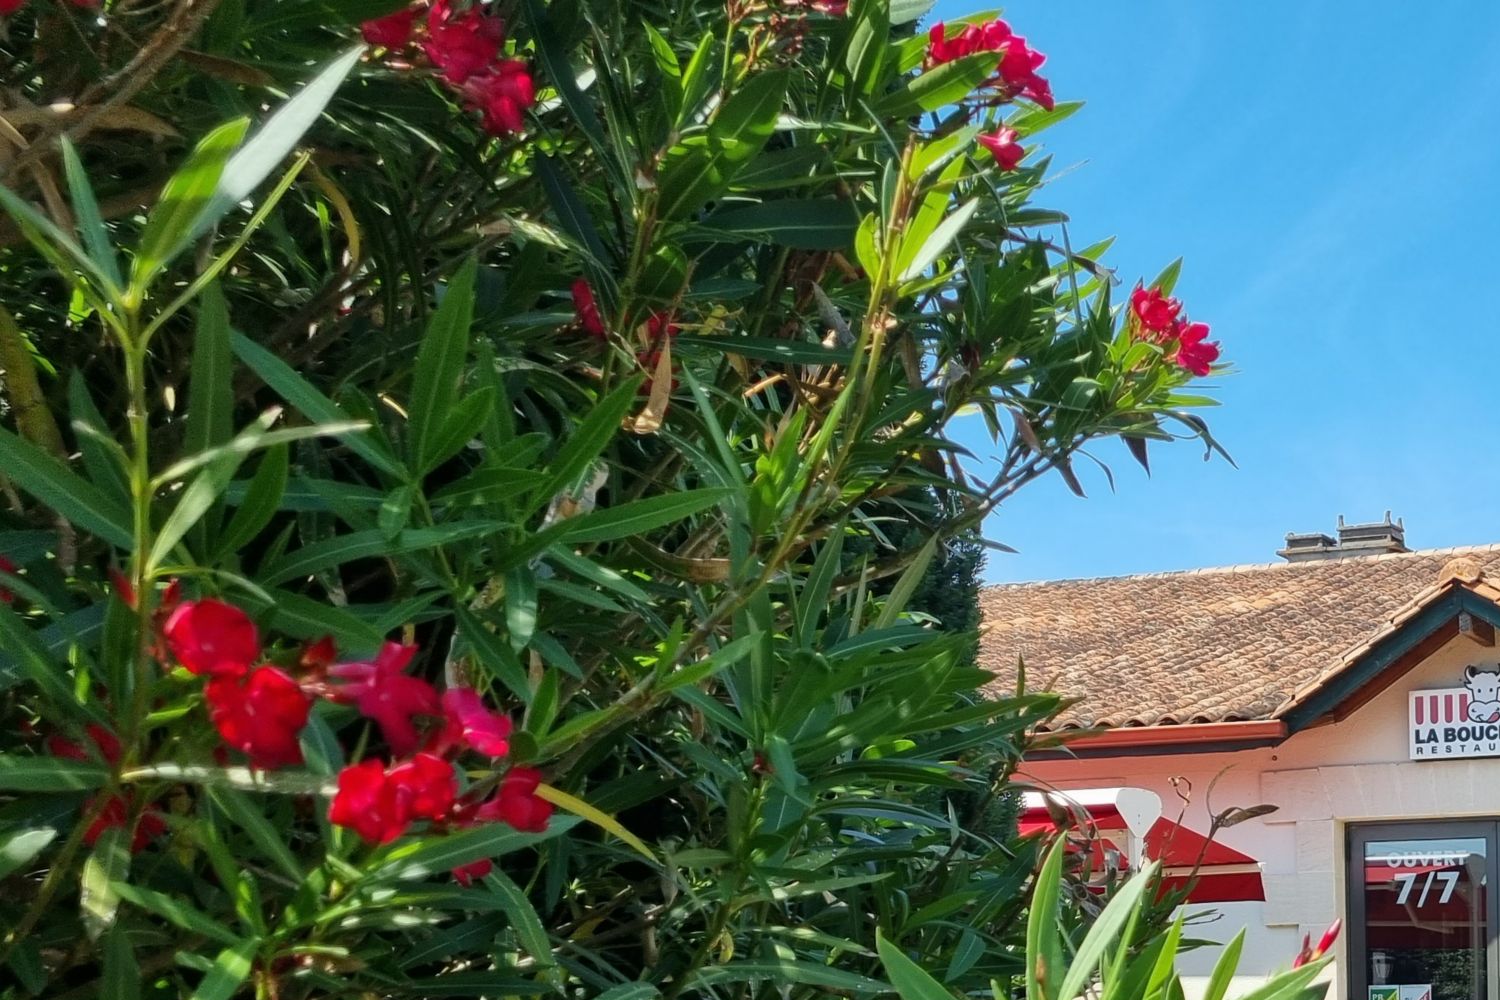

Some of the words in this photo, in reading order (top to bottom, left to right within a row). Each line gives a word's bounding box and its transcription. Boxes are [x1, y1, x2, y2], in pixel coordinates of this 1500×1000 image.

[1415, 728, 1439, 744] LA
[1387, 850, 1467, 868] OUVERT
[1394, 871, 1460, 908] 7/7
